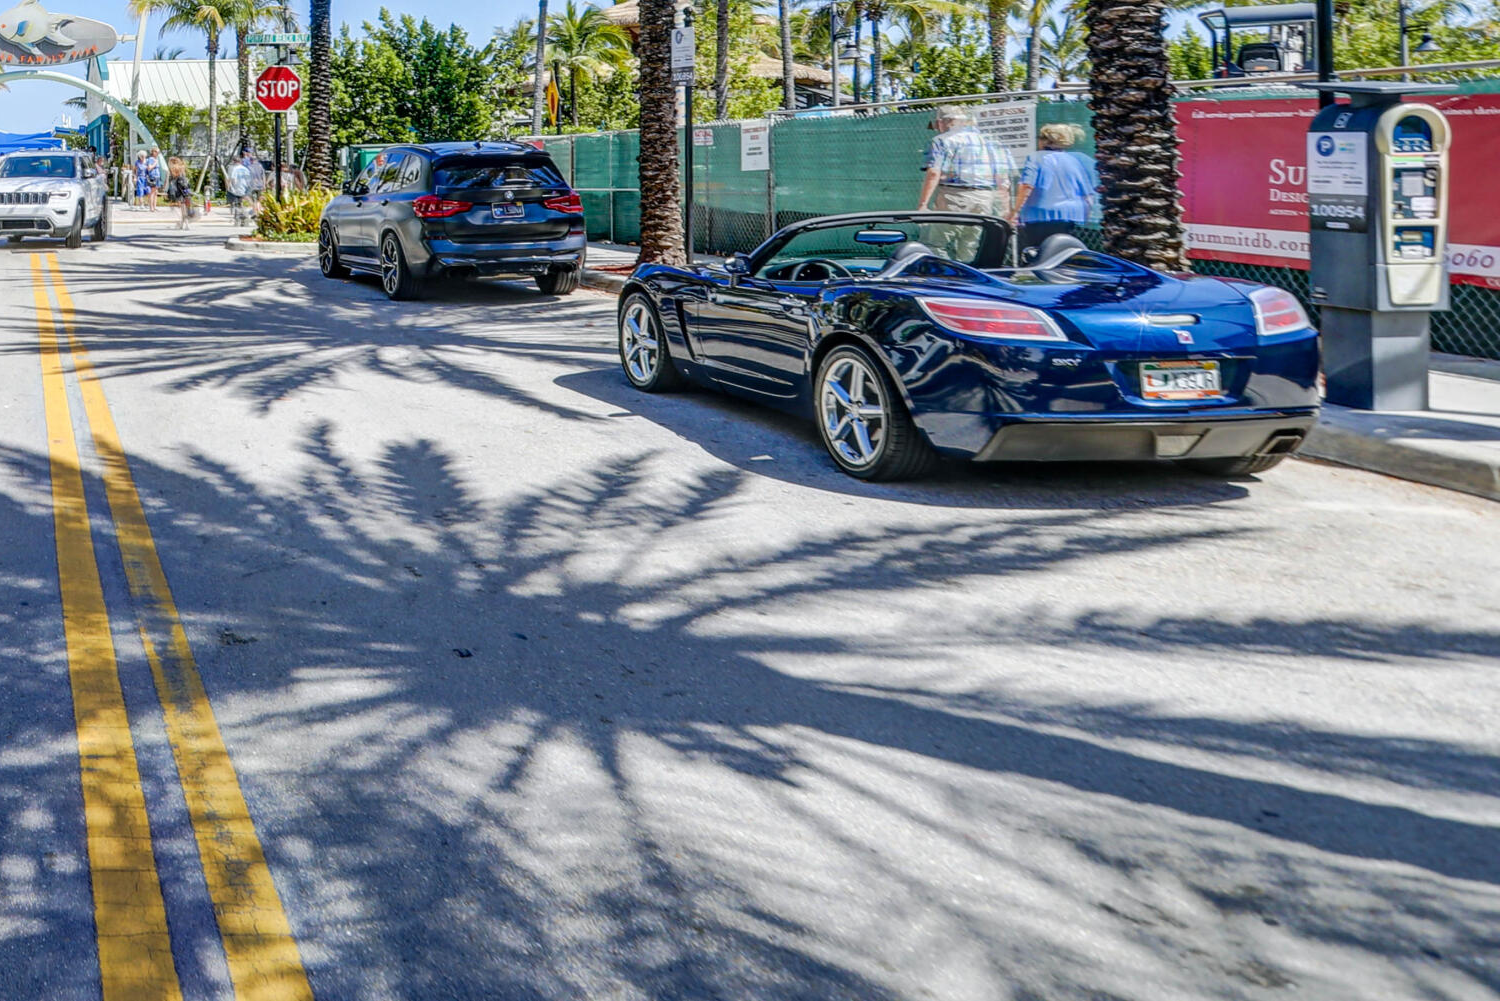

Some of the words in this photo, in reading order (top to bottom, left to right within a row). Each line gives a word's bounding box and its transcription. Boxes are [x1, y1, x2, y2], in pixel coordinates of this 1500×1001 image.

[258, 79, 298, 98] STOP
[1269, 158, 1306, 186] SU
[1311, 203, 1366, 220] 100954
[1443, 248, 1495, 269] 060
